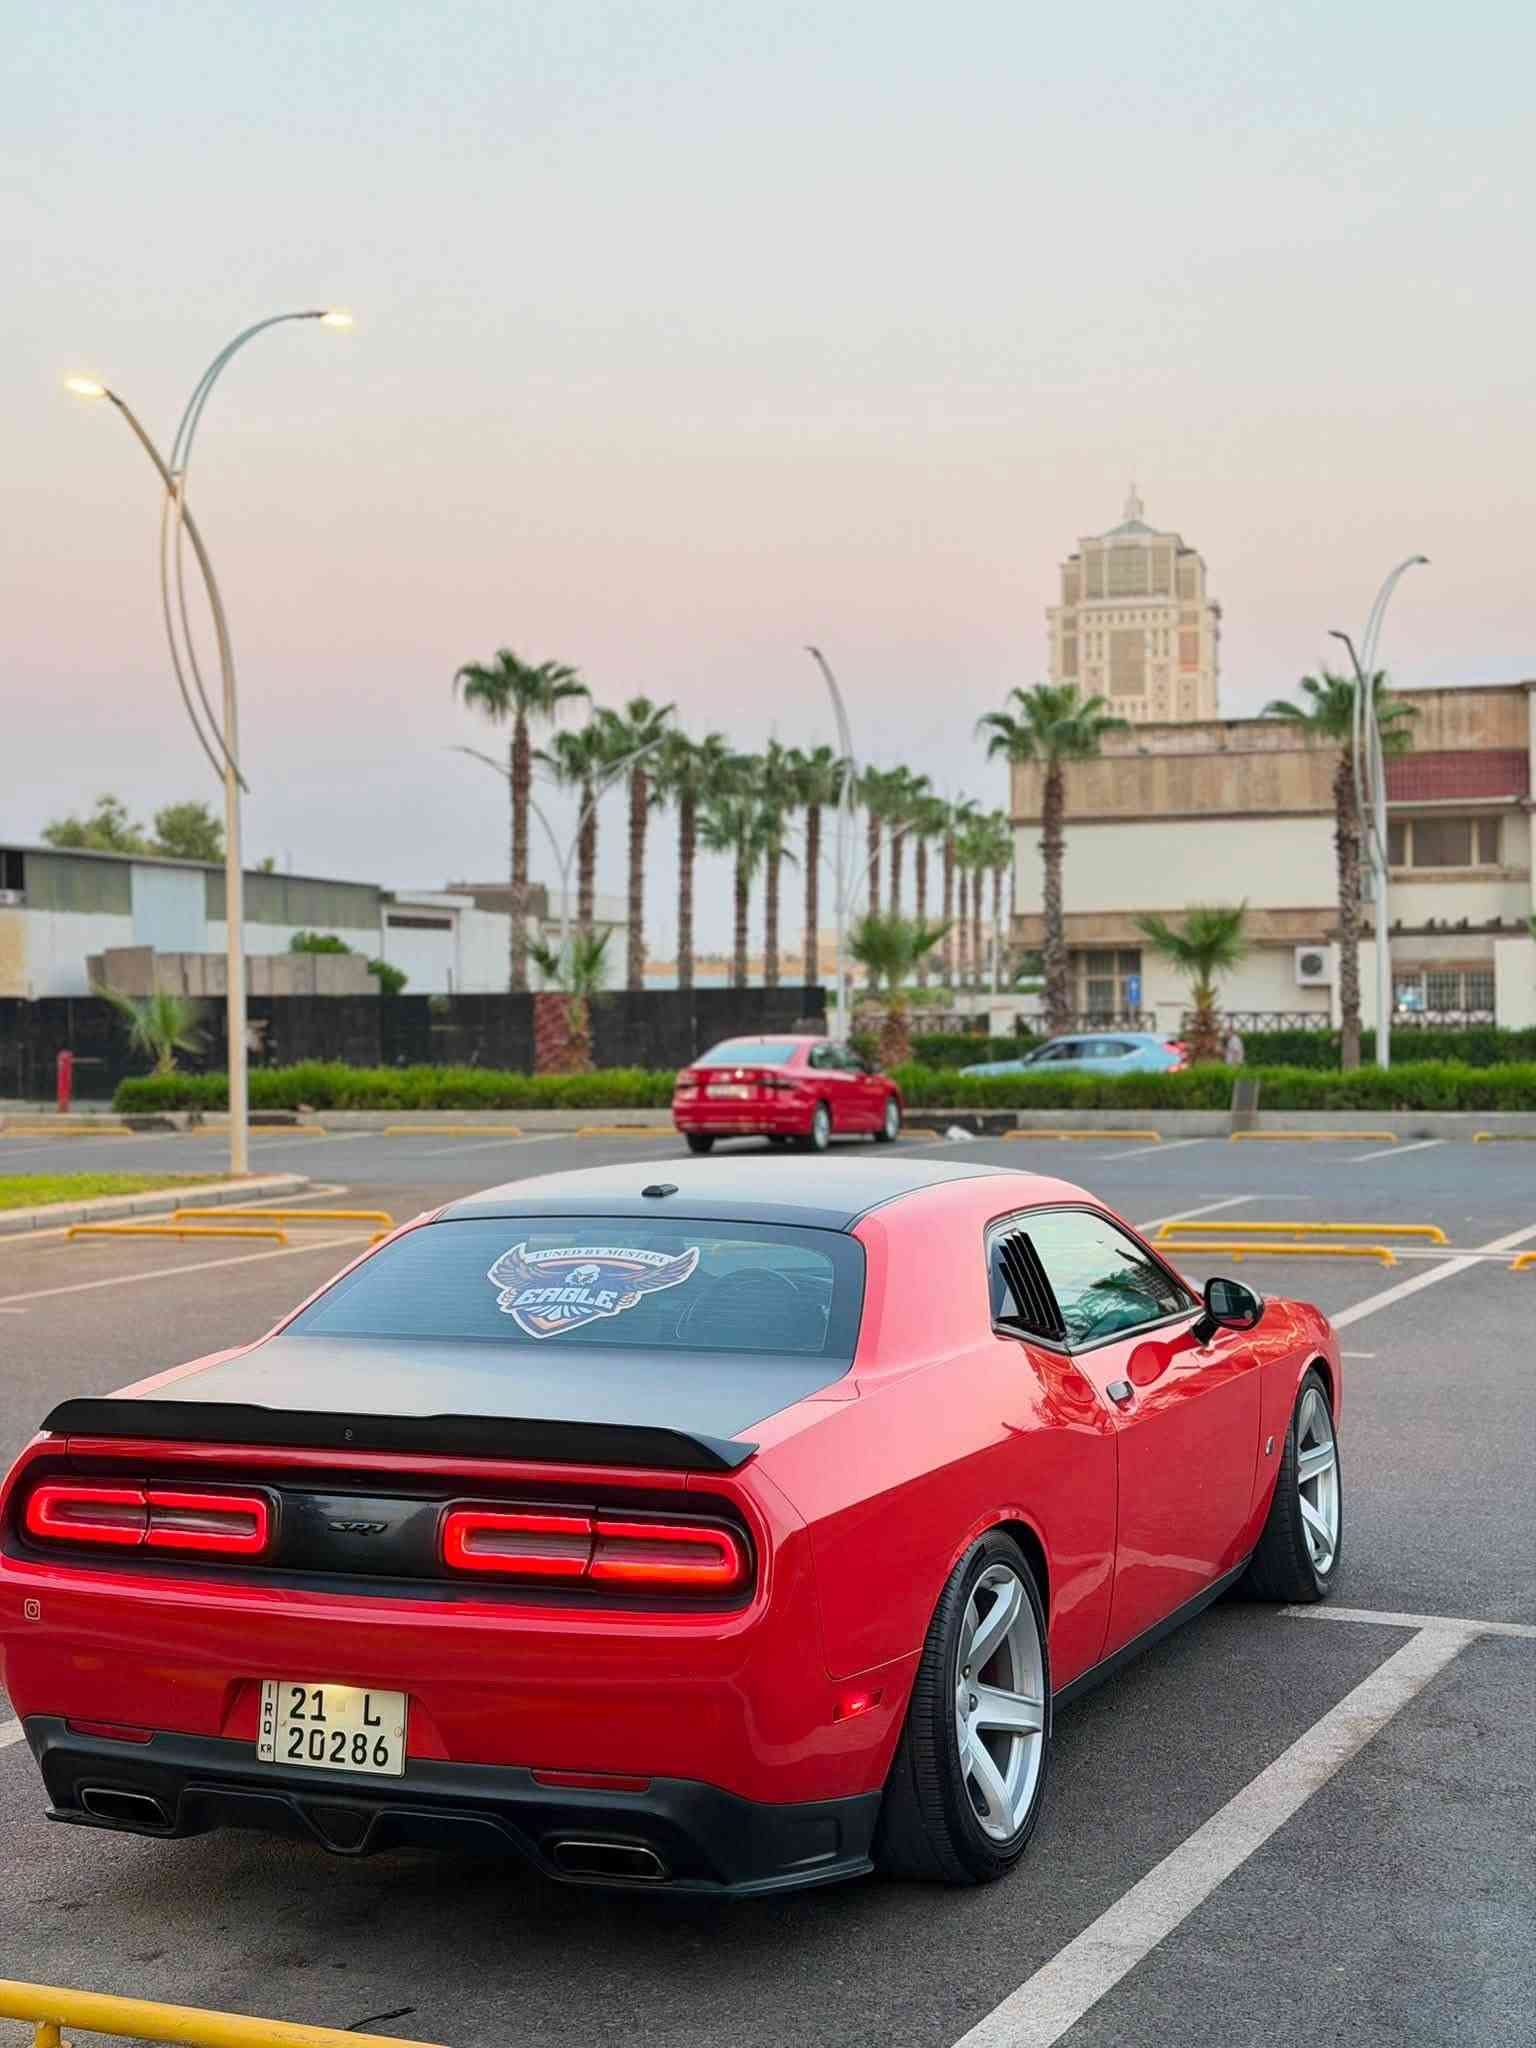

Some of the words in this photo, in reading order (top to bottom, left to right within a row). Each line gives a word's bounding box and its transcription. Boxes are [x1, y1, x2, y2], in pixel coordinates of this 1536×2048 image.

[535, 1248, 581, 1260] TUNED
[584, 1247, 602, 1257] BY
[513, 1287, 618, 1309] EAGLE
[289, 1687, 327, 1722] 21
[363, 1694, 381, 1727] L
[260, 1743, 272, 1753] KR
[287, 1726, 389, 1767] 20286
